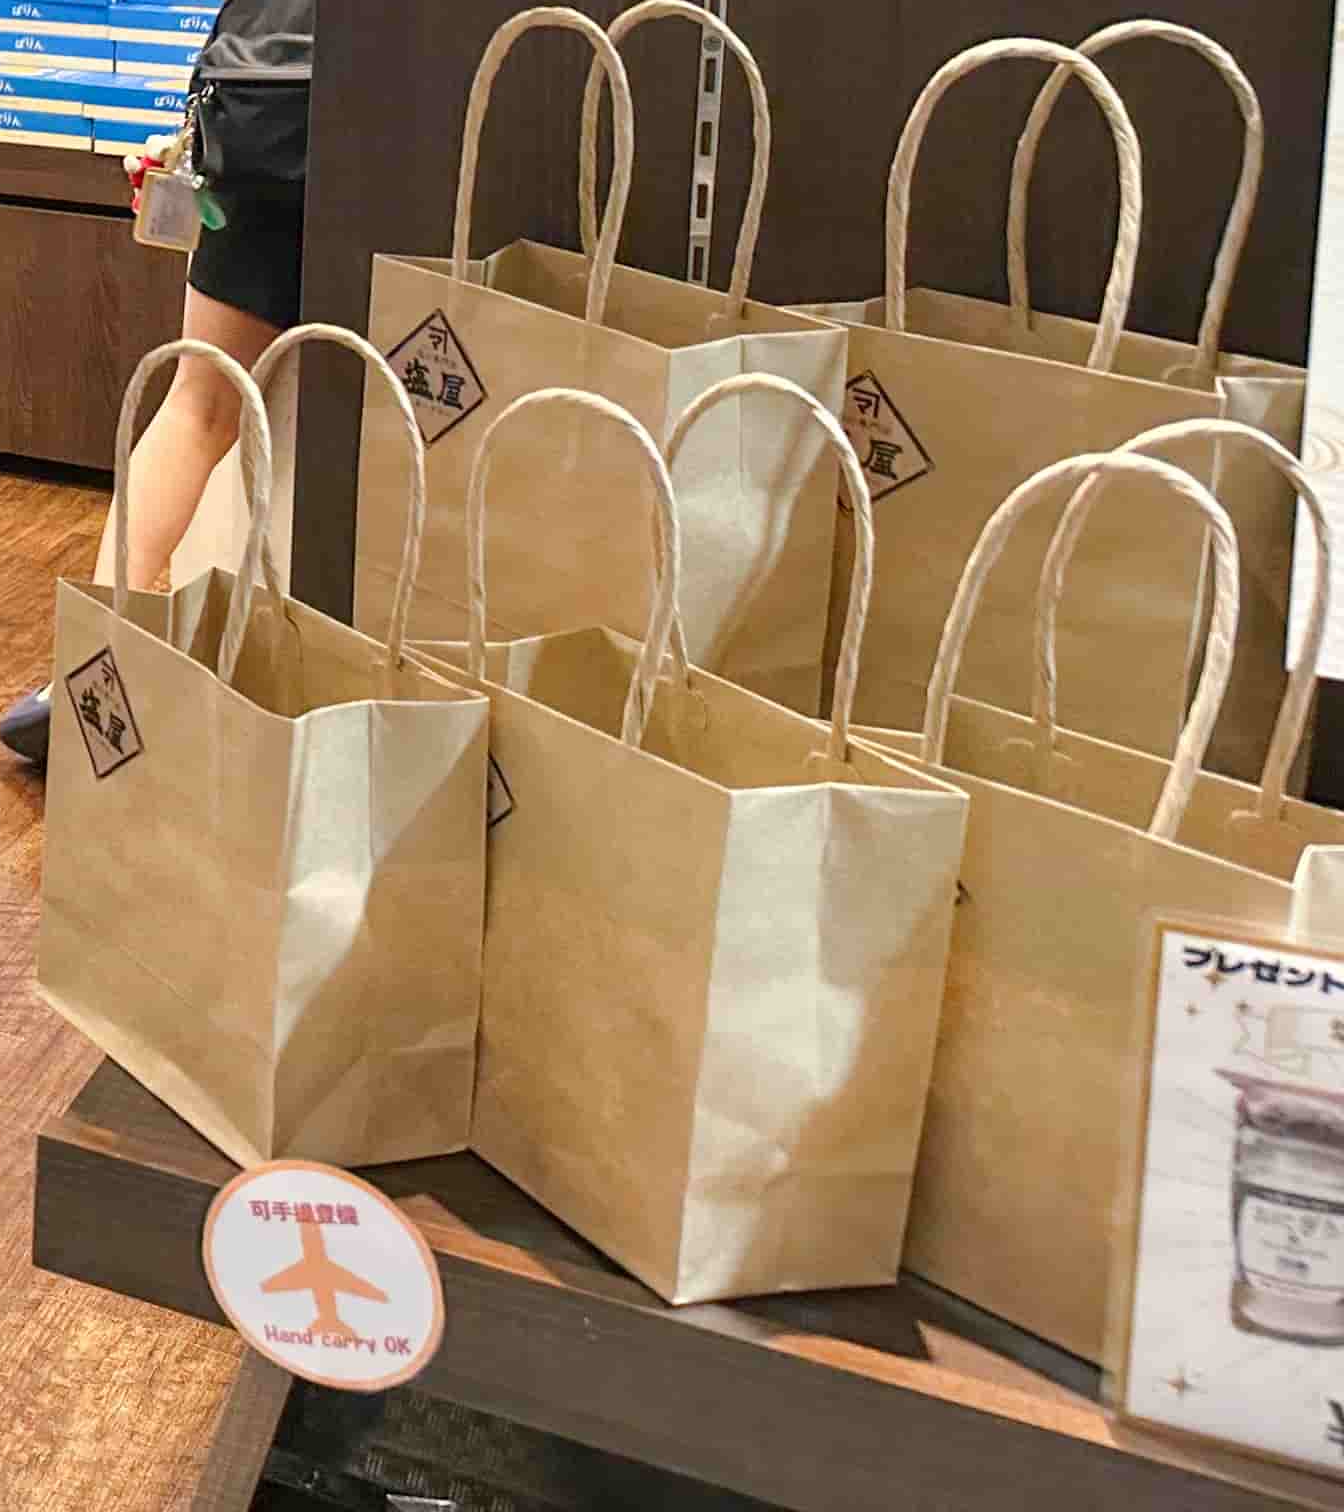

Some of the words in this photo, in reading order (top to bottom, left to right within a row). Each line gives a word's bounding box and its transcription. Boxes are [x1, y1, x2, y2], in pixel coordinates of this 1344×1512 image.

[264, 1324, 313, 1346] Hand
[321, 1333, 377, 1356] carry
[384, 1336, 412, 1356] OK
